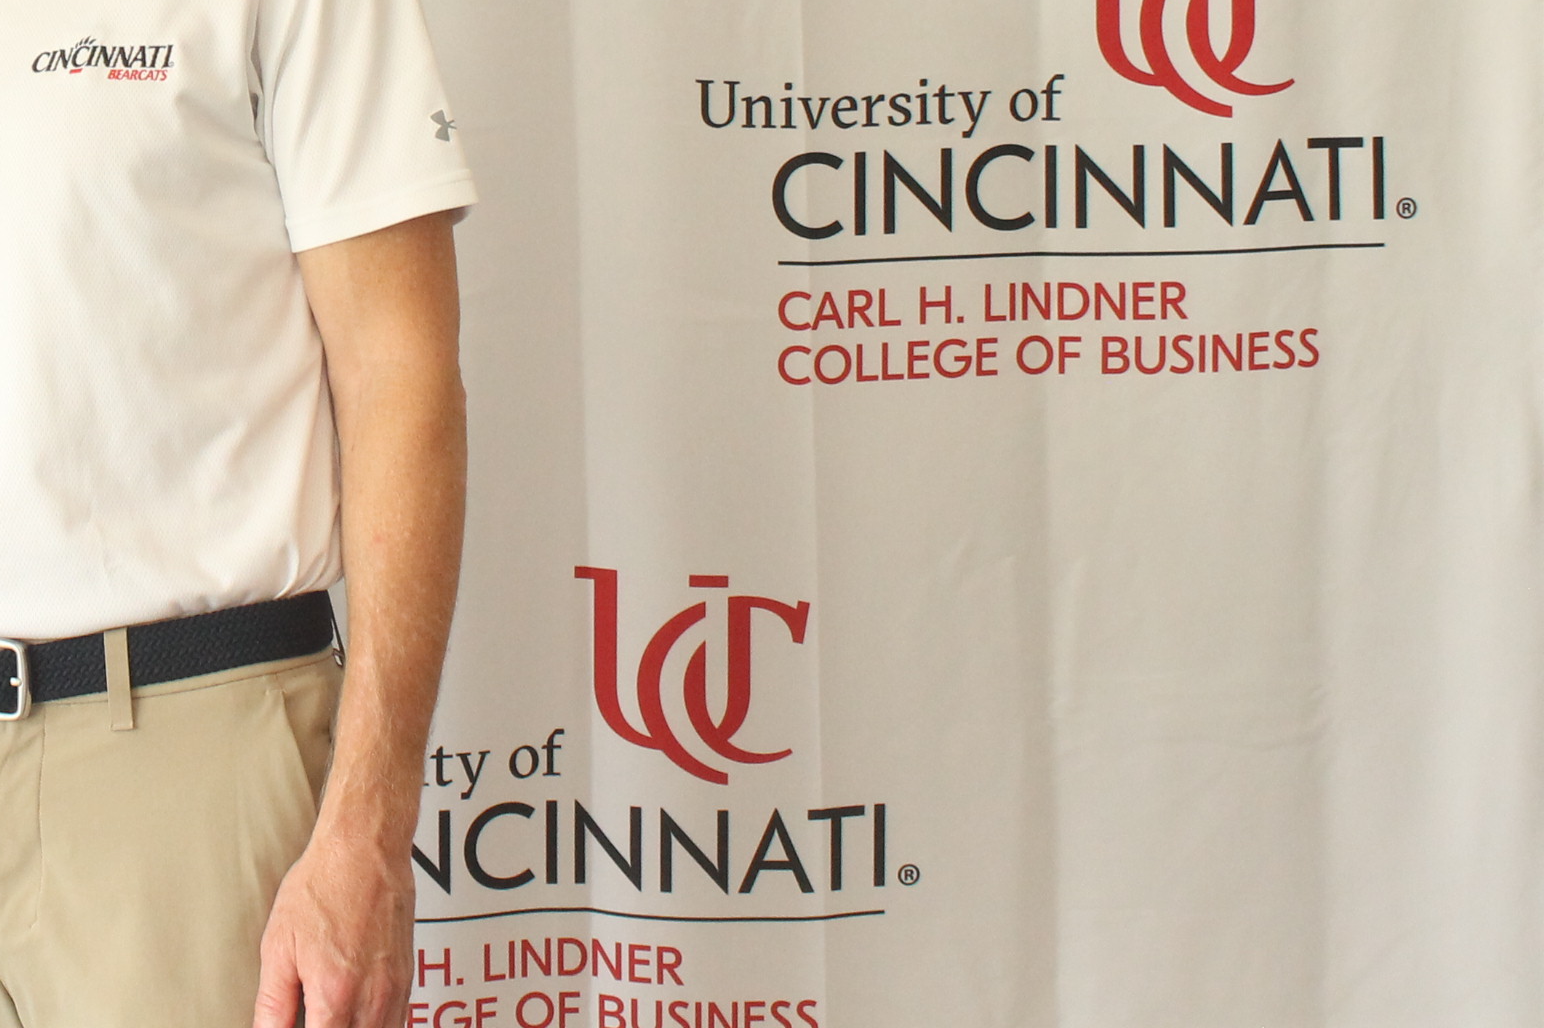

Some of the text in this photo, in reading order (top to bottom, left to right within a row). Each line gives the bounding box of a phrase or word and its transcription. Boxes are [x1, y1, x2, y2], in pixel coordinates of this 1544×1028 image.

[31, 38, 173, 73] CINCINNATI
[107, 68, 169, 82] BEARCATS
[696, 74, 1065, 138] University of
[777, 281, 1188, 331] CARL H. LINDNER
[777, 328, 1320, 385] COLLEGE OF BUSINESS
[509, 728, 565, 779] of
[418, 937, 684, 987] H. LINDNER
[516, 991, 581, 1028] OF
[599, 994, 819, 1028] BUSINESS
